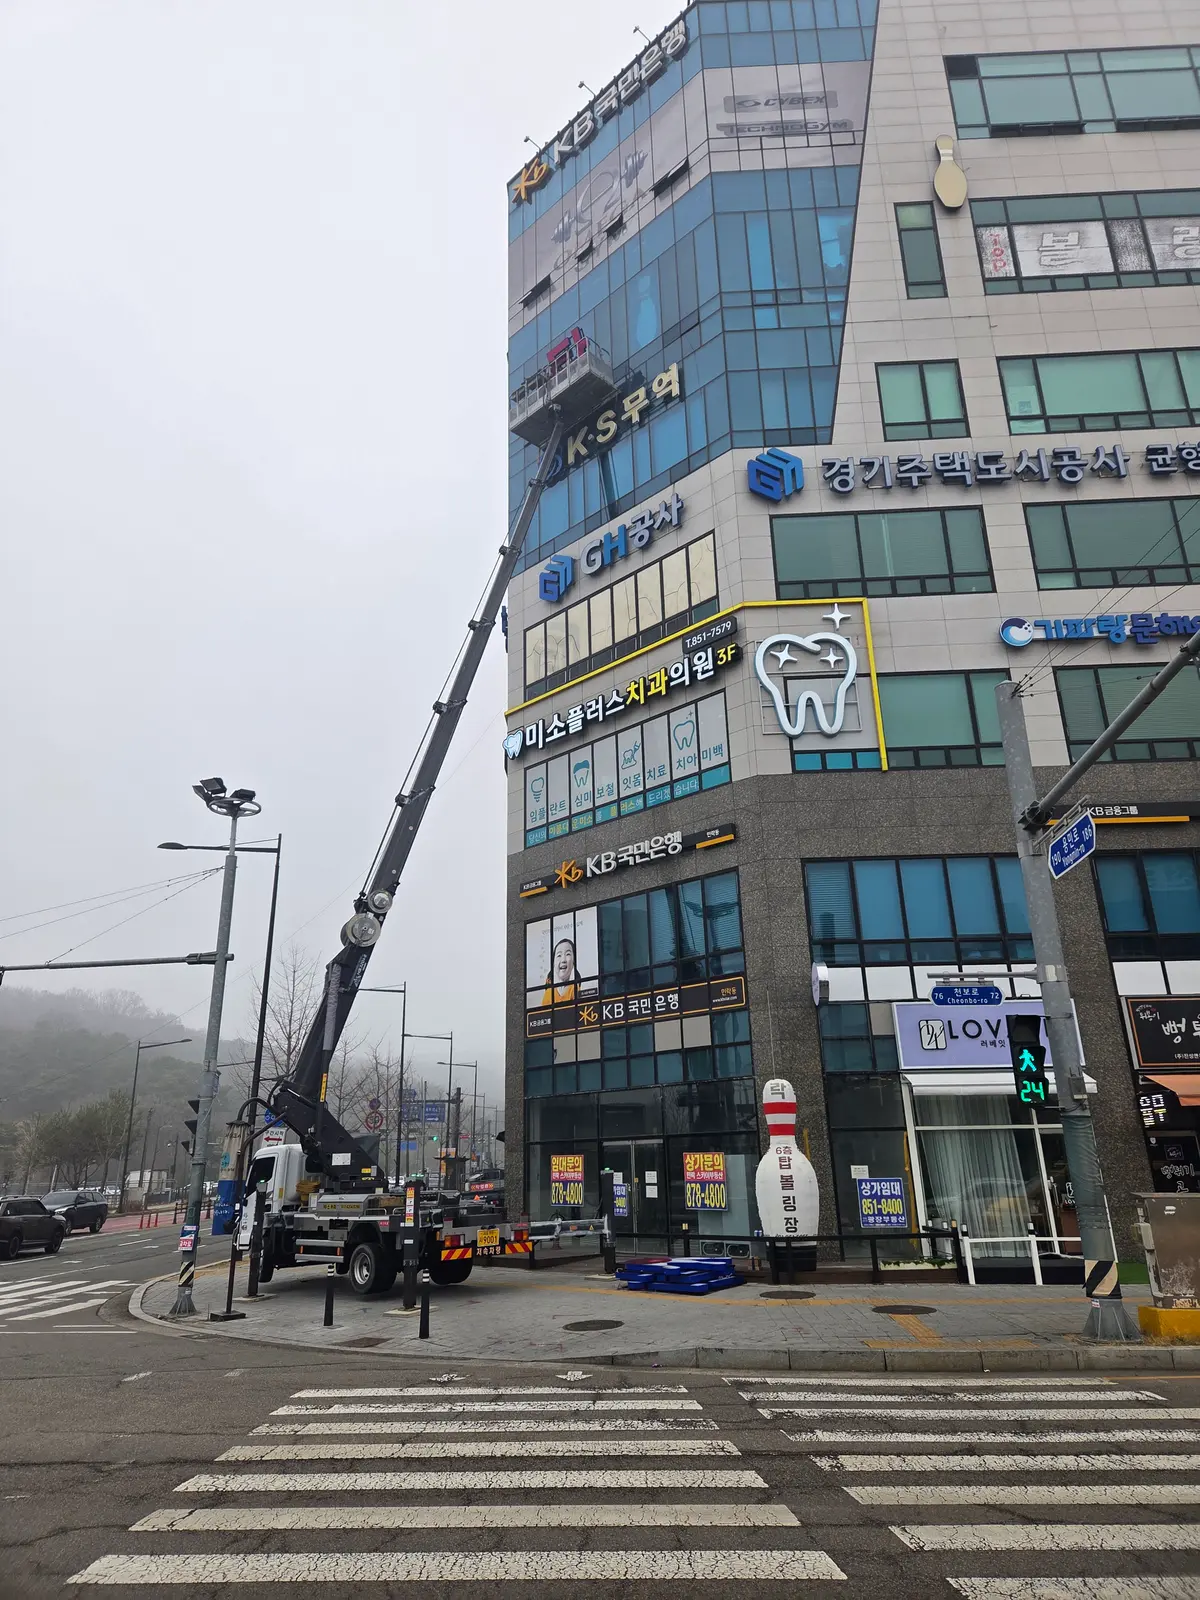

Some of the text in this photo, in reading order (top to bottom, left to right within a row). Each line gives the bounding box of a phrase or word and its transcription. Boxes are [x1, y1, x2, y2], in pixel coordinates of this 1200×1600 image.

[554, 20, 687, 165] KB국민은행
[763, 95, 826, 107] CYBEX
[822, 443, 1130, 494] 경기주택도시공사
[685, 620, 732, 648] T.851-7579
[525, 643, 736, 749] 미소플러스치과의원 3F
[1086, 805, 1139, 817] KB금융그룹
[1062, 823, 1093, 854] 용민로 186
[586, 830, 683, 878] KB국민은행
[1050, 843, 1086, 868] 190 Yongmin-ro
[934, 987, 1000, 1000] 76 천보로 72
[1020, 1080, 1045, 1102] 24
[775, 1146, 793, 1155] 6층
[551, 1156, 582, 1172] 임대문의
[685, 1153, 724, 1172] 상가문의
[551, 1182, 583, 1205] 878-4800
[686, 1182, 726, 1208] 878-4800
[861, 1181, 901, 1196] 상가임대
[861, 1198, 903, 1215] 851-8400
